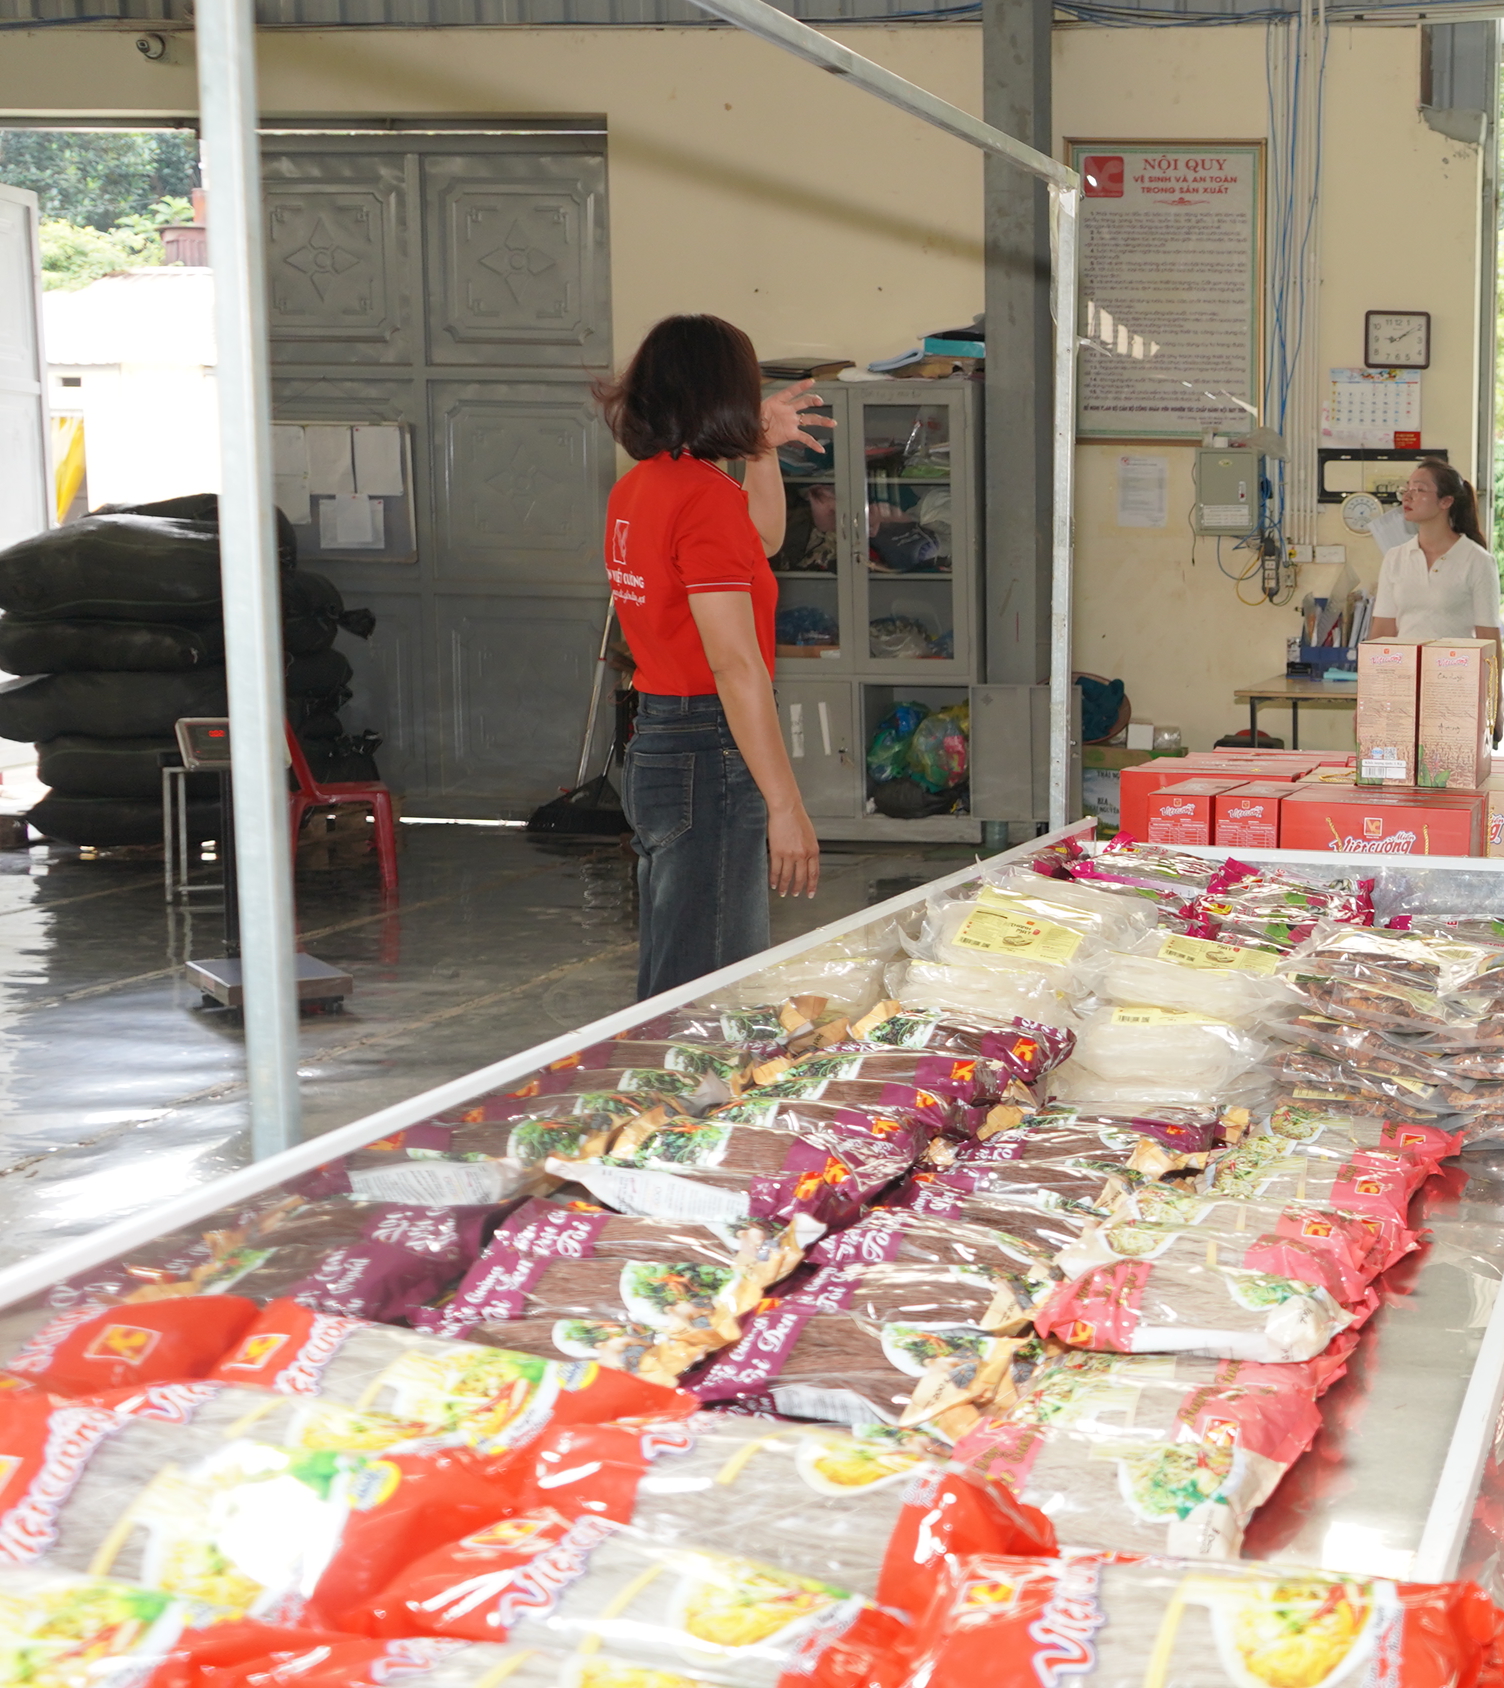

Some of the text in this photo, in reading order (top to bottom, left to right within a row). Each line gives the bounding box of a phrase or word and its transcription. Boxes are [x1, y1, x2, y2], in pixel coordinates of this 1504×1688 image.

[1142, 155, 1227, 174] NỘI QUY
[1133, 174, 1145, 184] VỆ
[1174, 174, 1187, 183] VÀ
[1209, 174, 1238, 183] TOÀN
[1179, 185, 1199, 194] SẢN
[1203, 184, 1229, 194] XUẤT
[623, 570, 645, 589] CƯỜNG
